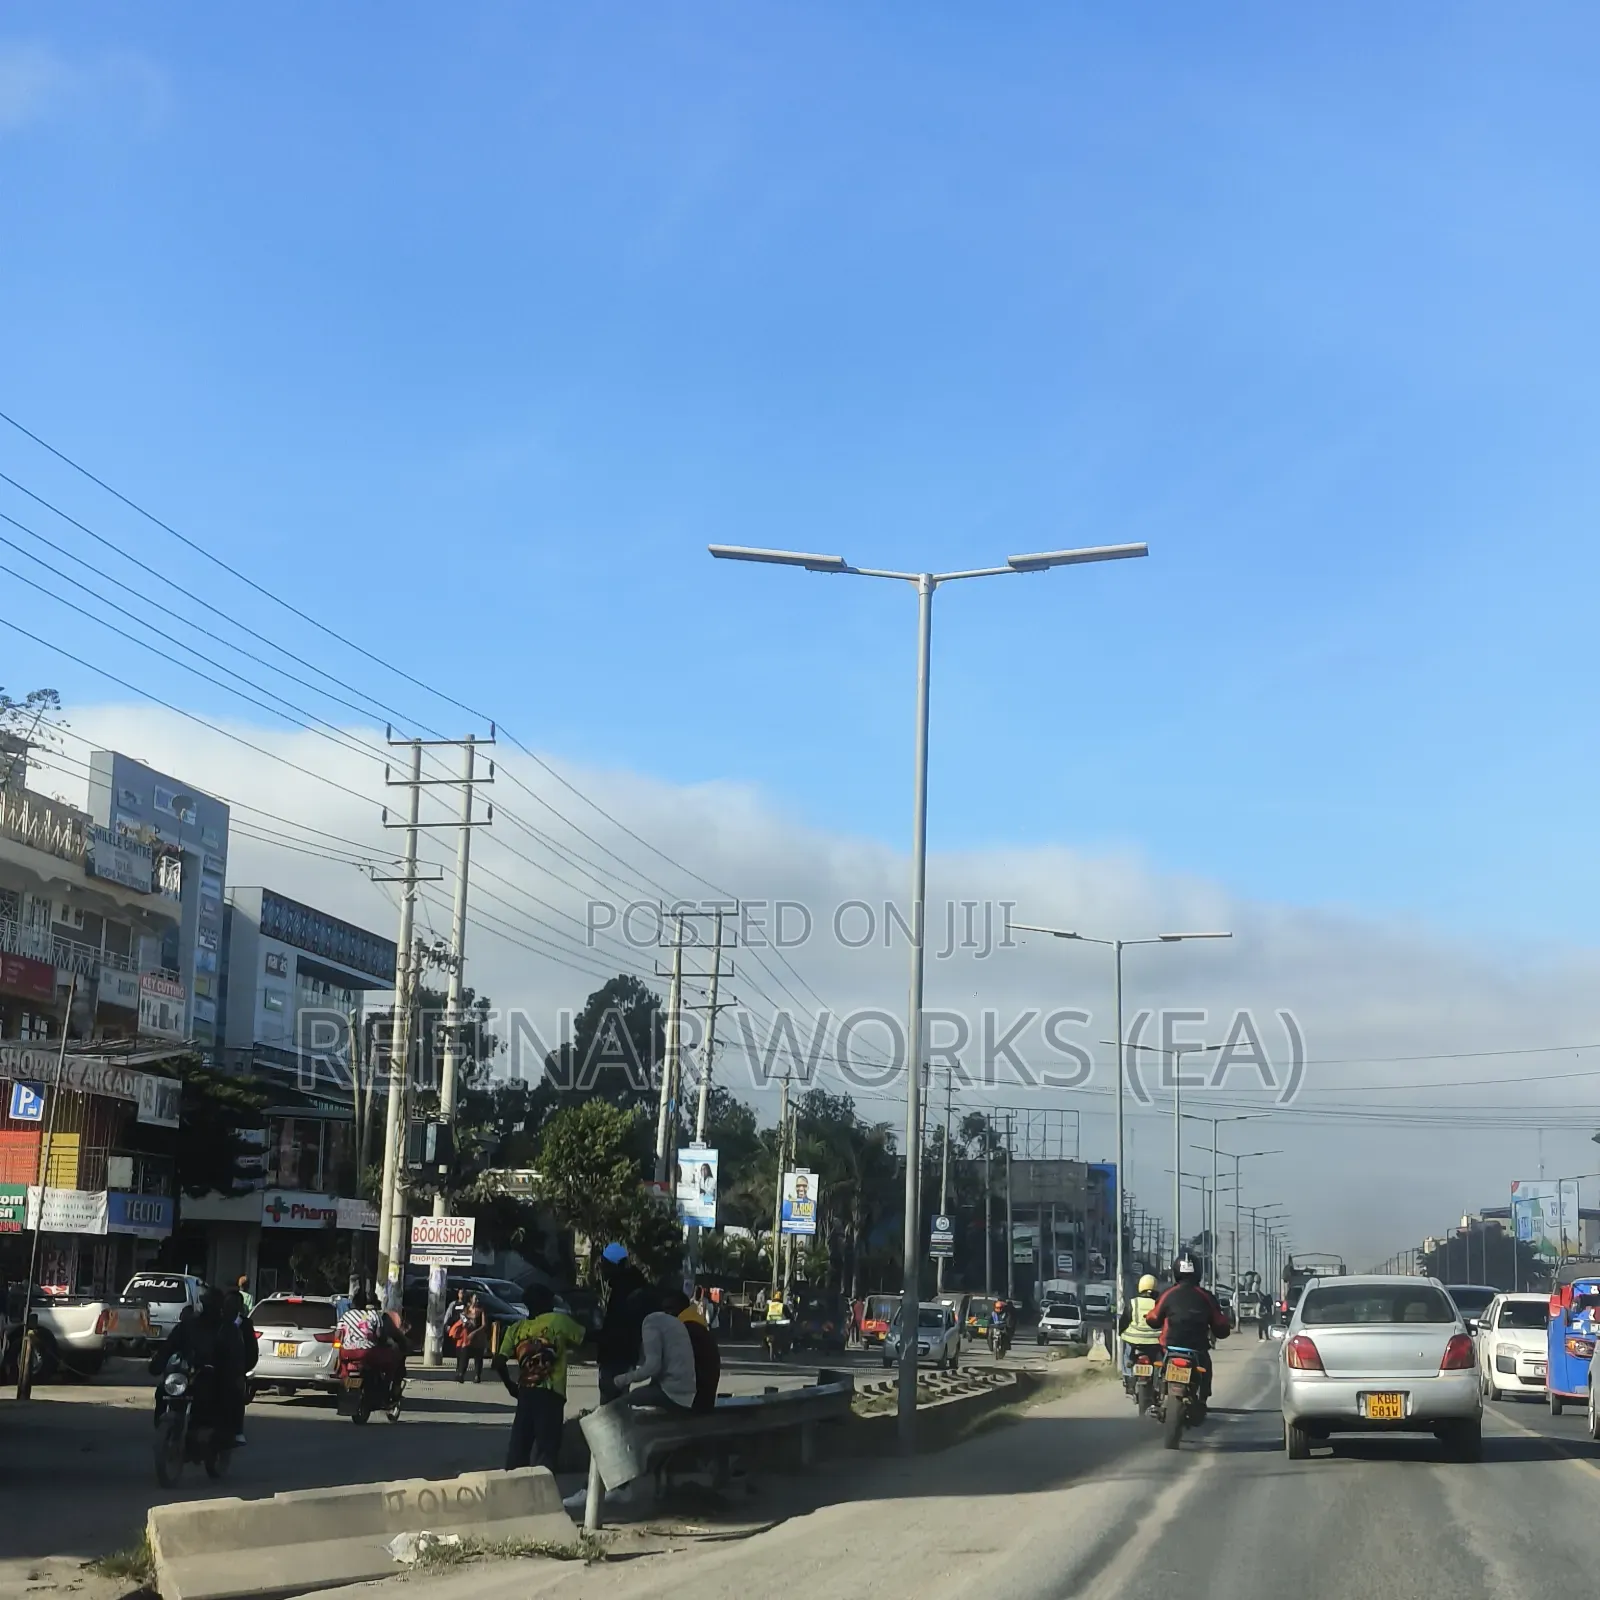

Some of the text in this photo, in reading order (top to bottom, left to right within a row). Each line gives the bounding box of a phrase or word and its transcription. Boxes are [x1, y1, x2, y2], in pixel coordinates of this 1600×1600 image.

[95, 827, 122, 849] MILELE
[124, 839, 152, 860] CENTRE
[143, 975, 157, 990] KEY
[157, 981, 185, 999] CUTTING
[126, 1199, 164, 1223] TECNO
[420, 1218, 466, 1227] A-PLUS
[413, 1227, 472, 1244] BOOKSHOP
[1372, 1405, 1399, 1417] 581W
